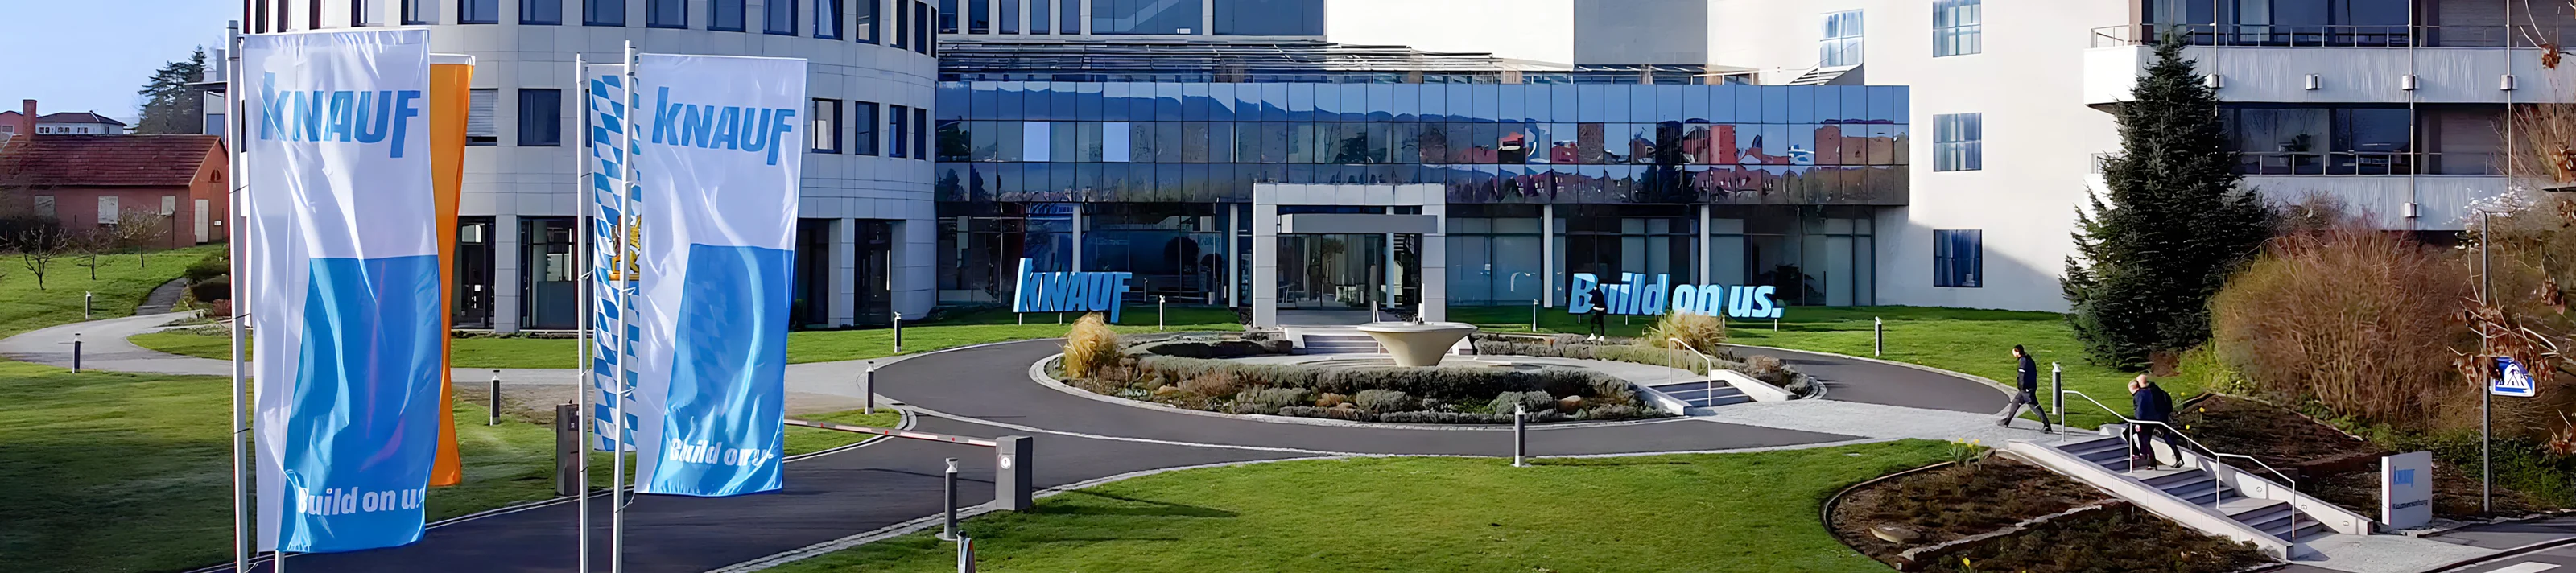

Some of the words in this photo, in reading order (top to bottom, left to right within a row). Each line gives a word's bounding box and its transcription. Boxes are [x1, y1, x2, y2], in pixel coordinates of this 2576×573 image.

[1672, 284, 1724, 317] on
[1728, 285, 1785, 318] us.
[362, 490, 396, 512] on
